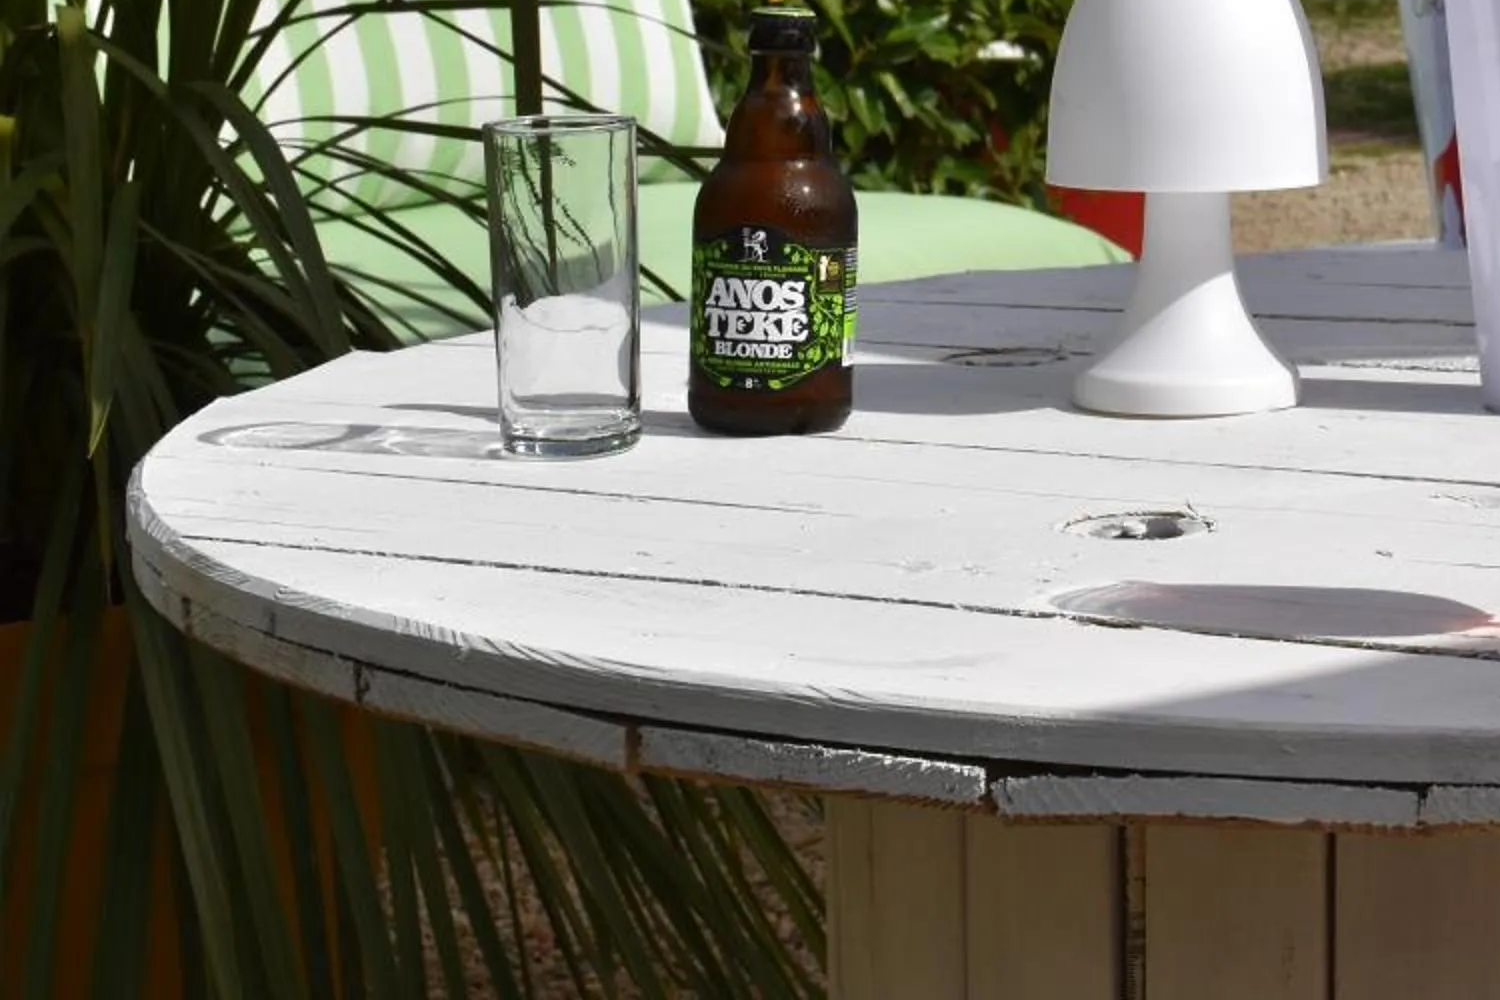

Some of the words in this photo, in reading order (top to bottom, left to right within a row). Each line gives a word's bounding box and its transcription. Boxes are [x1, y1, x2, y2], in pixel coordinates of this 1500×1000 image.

[705, 277, 805, 310] ANOS
[705, 307, 809, 342] TEKE
[715, 339, 793, 359] BLONDE
